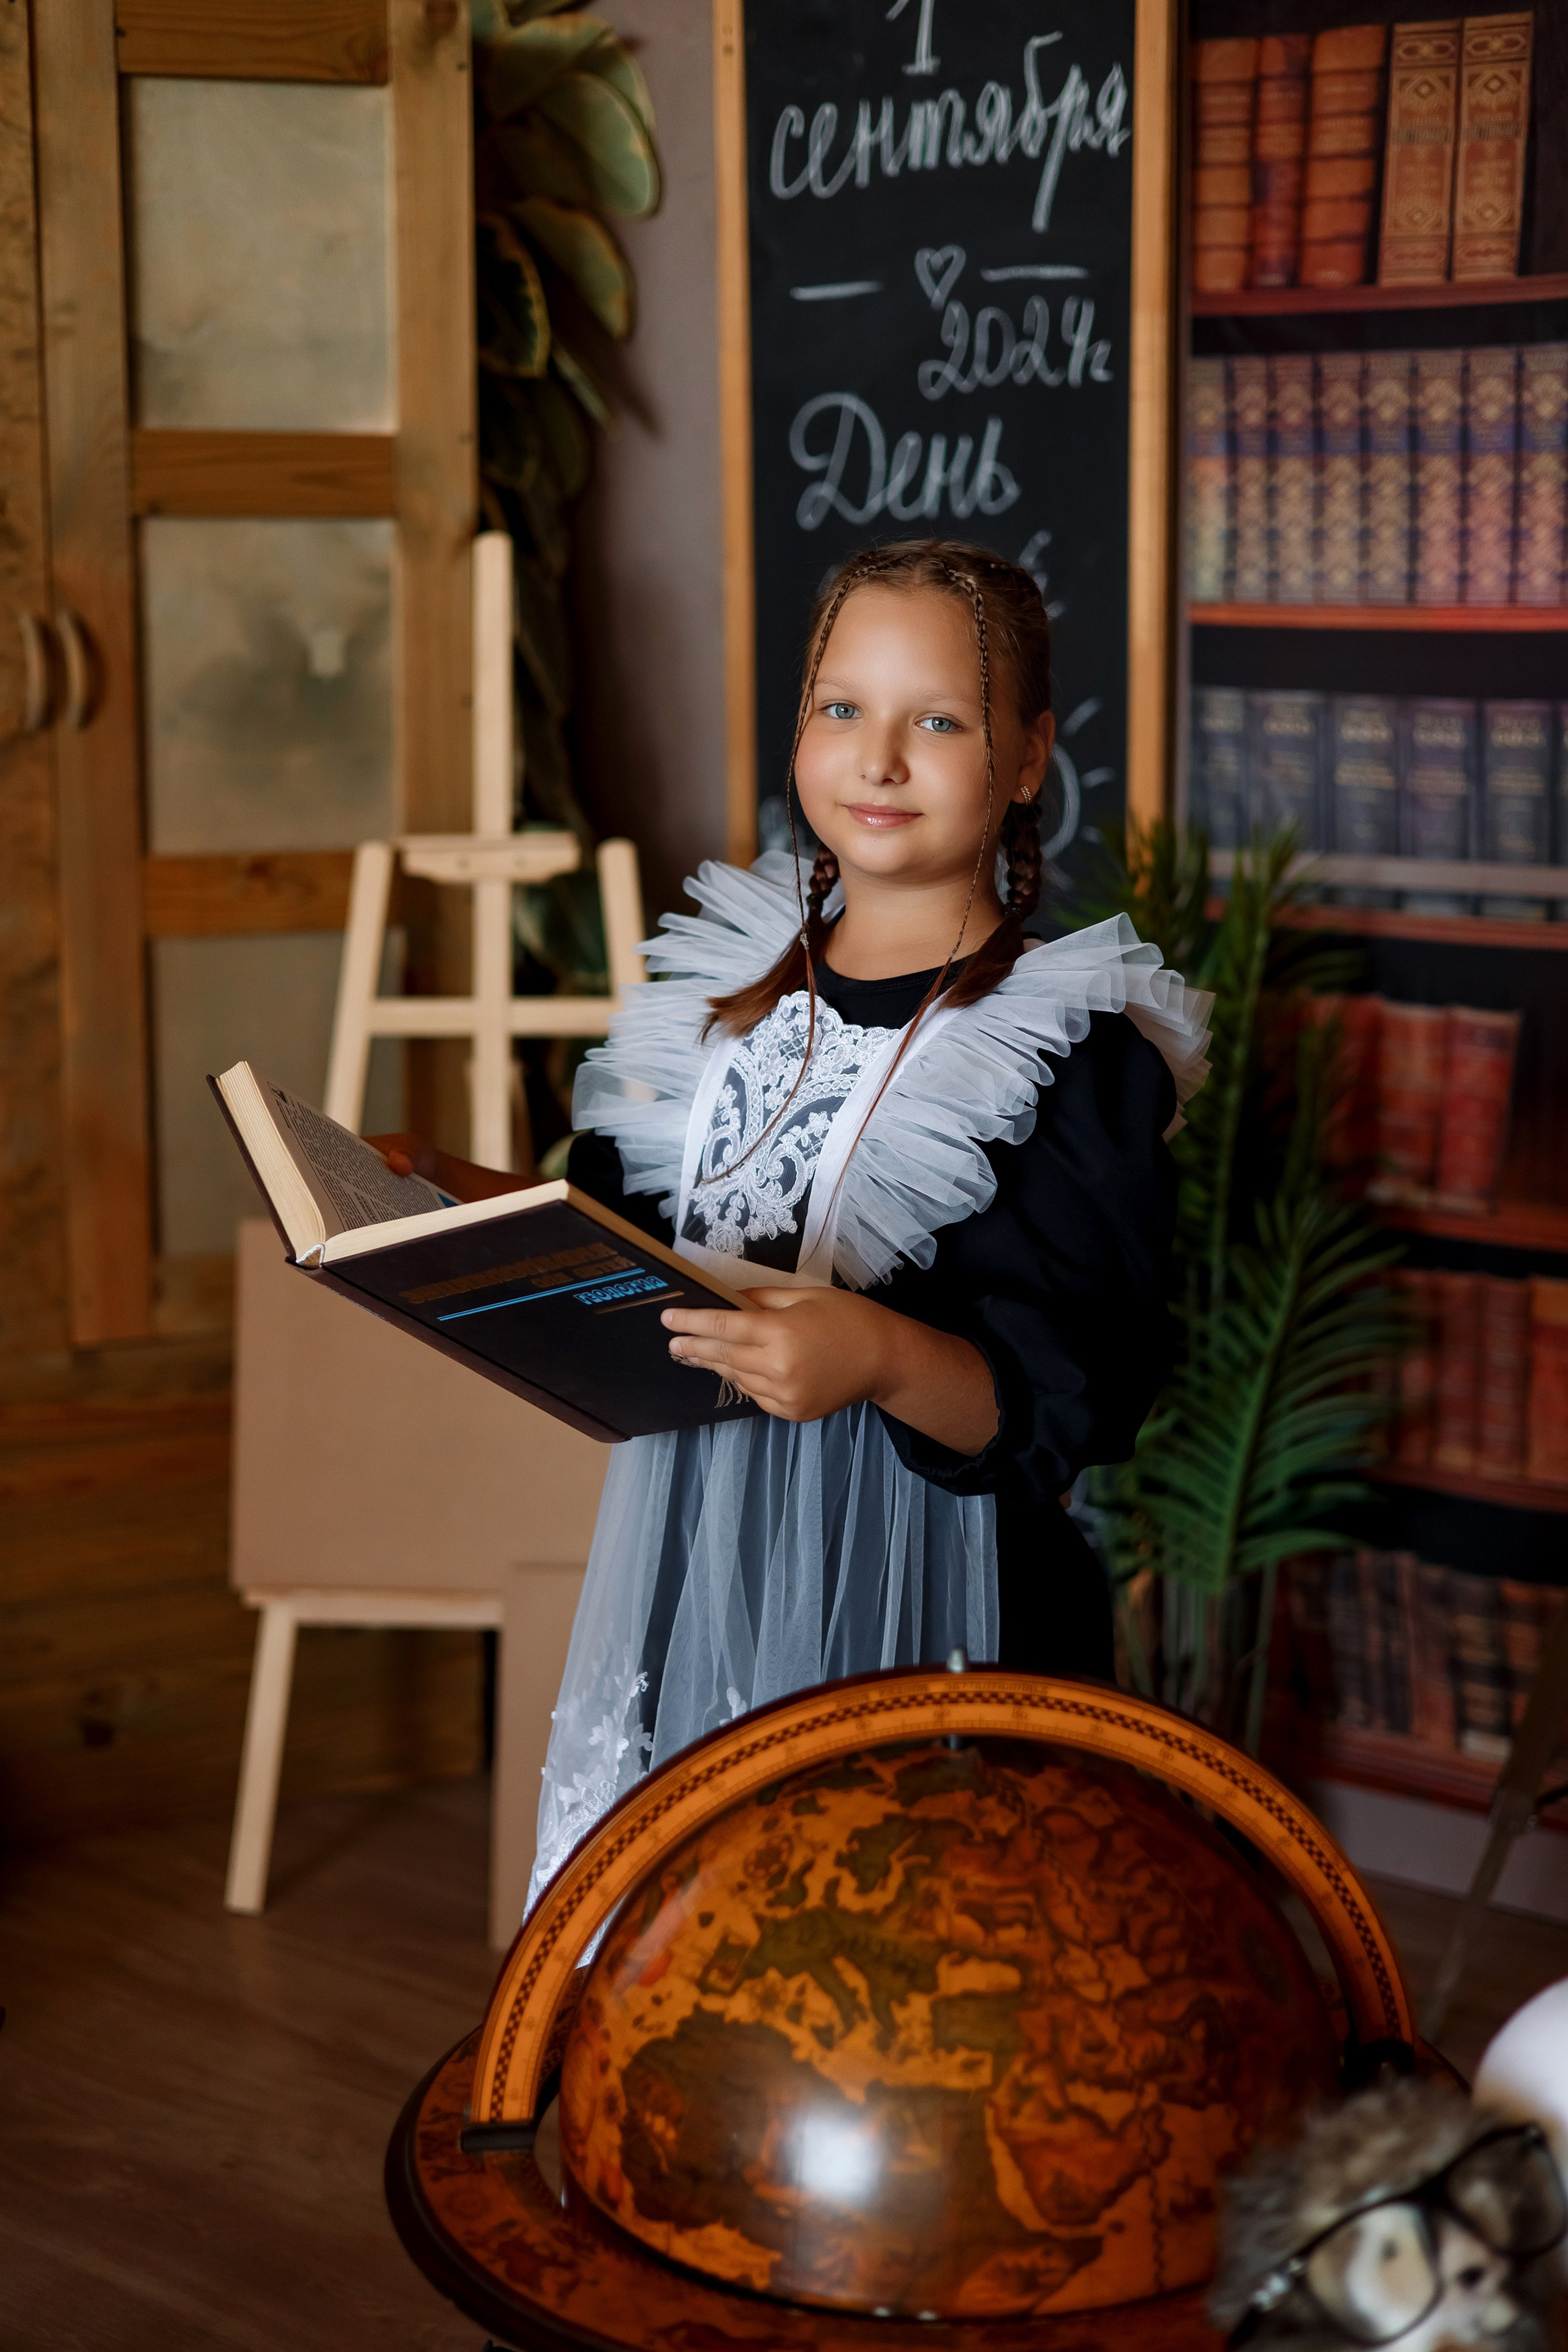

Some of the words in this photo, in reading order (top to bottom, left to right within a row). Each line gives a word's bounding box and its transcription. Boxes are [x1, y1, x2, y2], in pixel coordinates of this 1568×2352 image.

[886, 0, 940, 75] 1
[790, 393, 1020, 530] День
[574, 1276, 668, 1305] ГЕОЛОГИЯ
